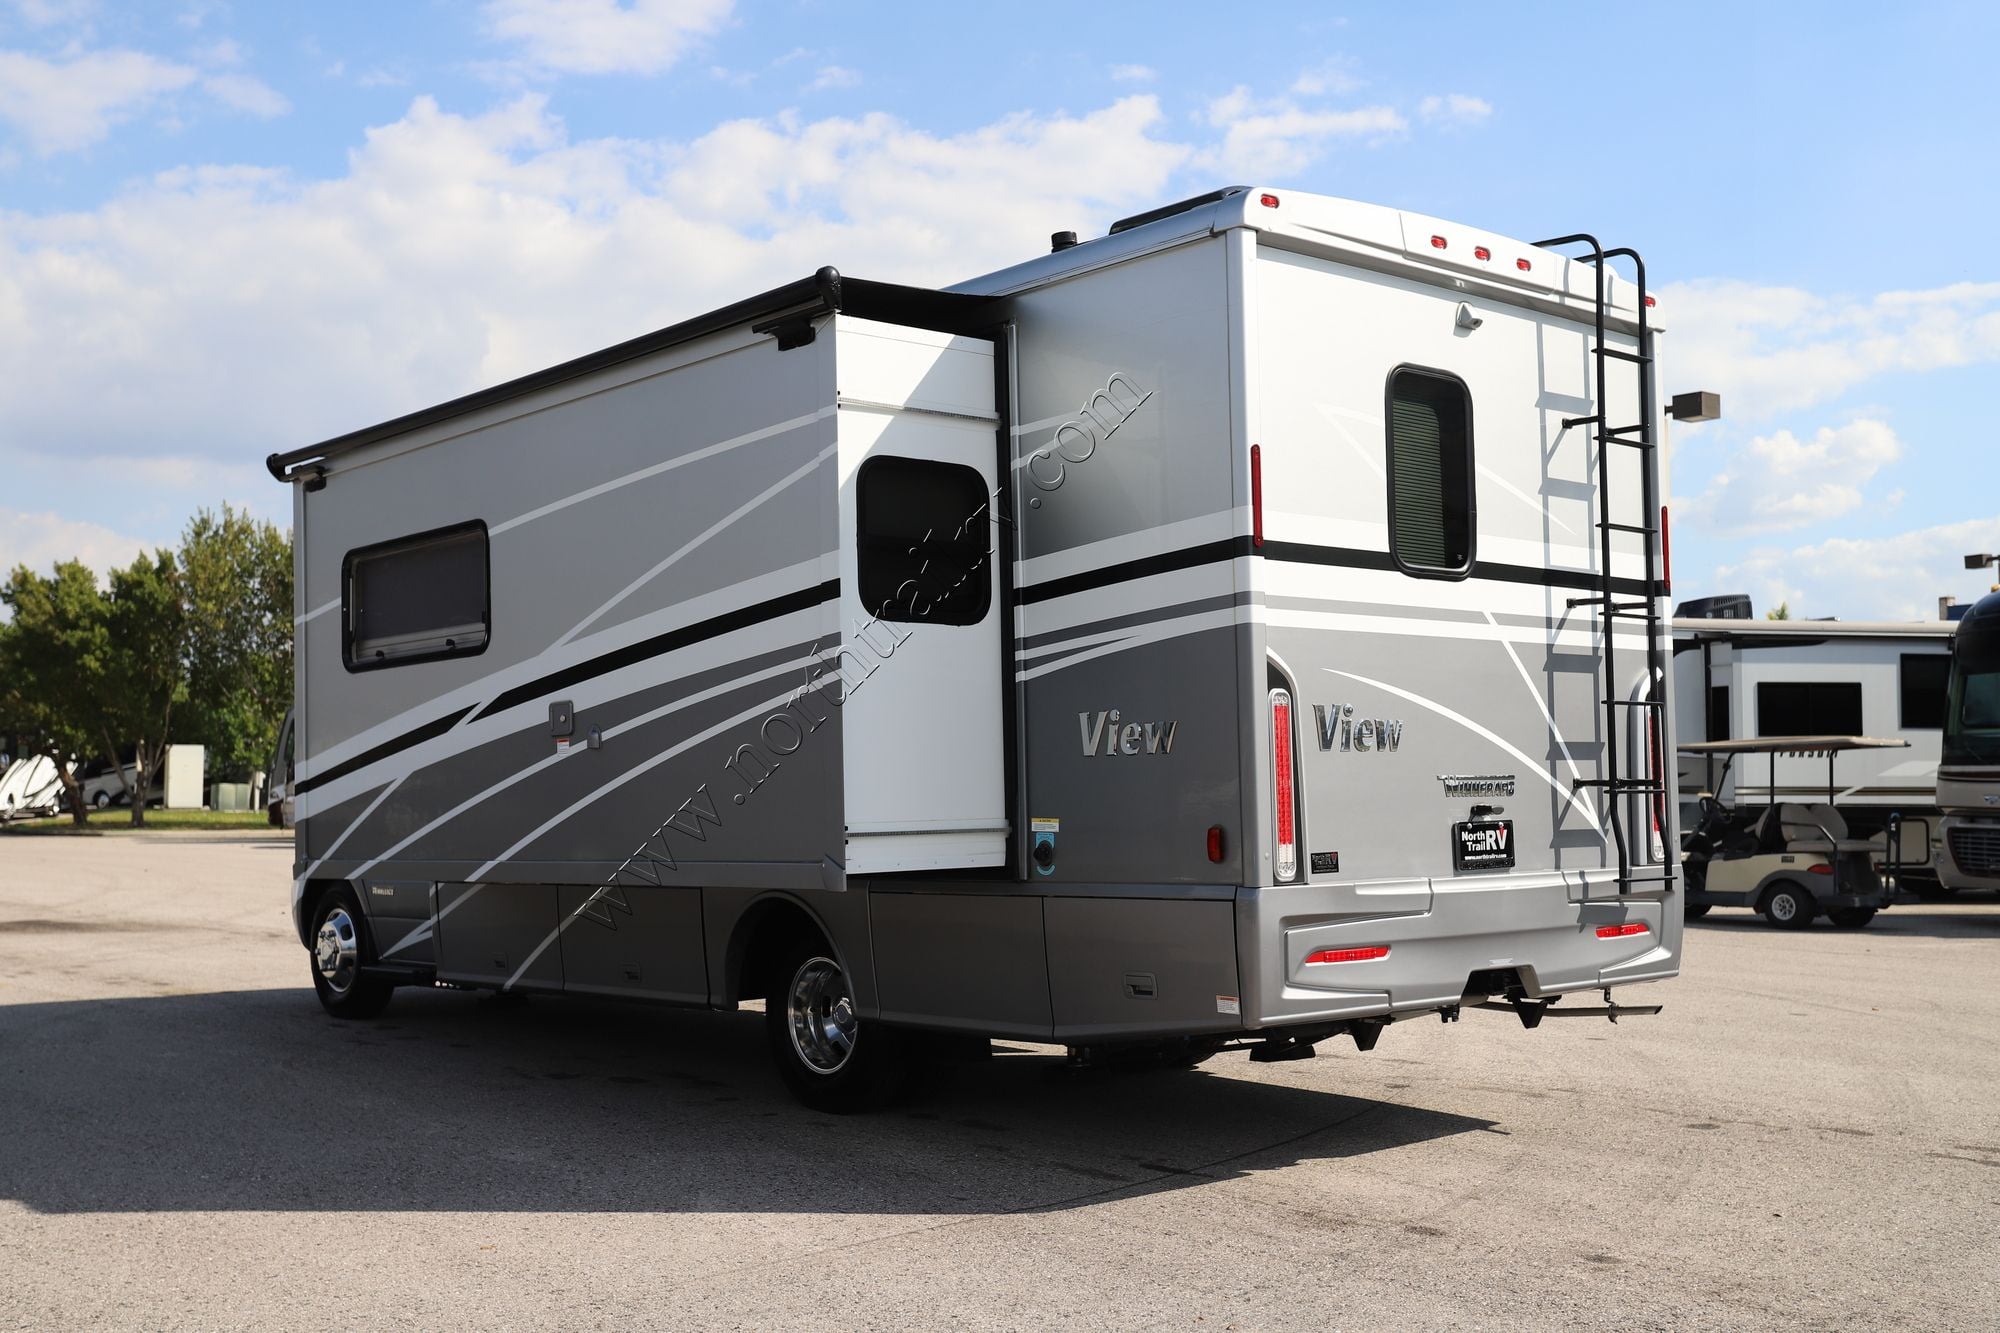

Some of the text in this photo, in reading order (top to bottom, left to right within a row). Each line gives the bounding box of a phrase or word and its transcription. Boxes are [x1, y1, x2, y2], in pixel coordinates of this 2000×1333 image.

[1078, 709, 1178, 757] View
[1312, 703, 1403, 752] View
[1461, 831, 1486, 841] North
[1466, 841, 1486, 851] Trail
[1485, 829, 1508, 850] RV
